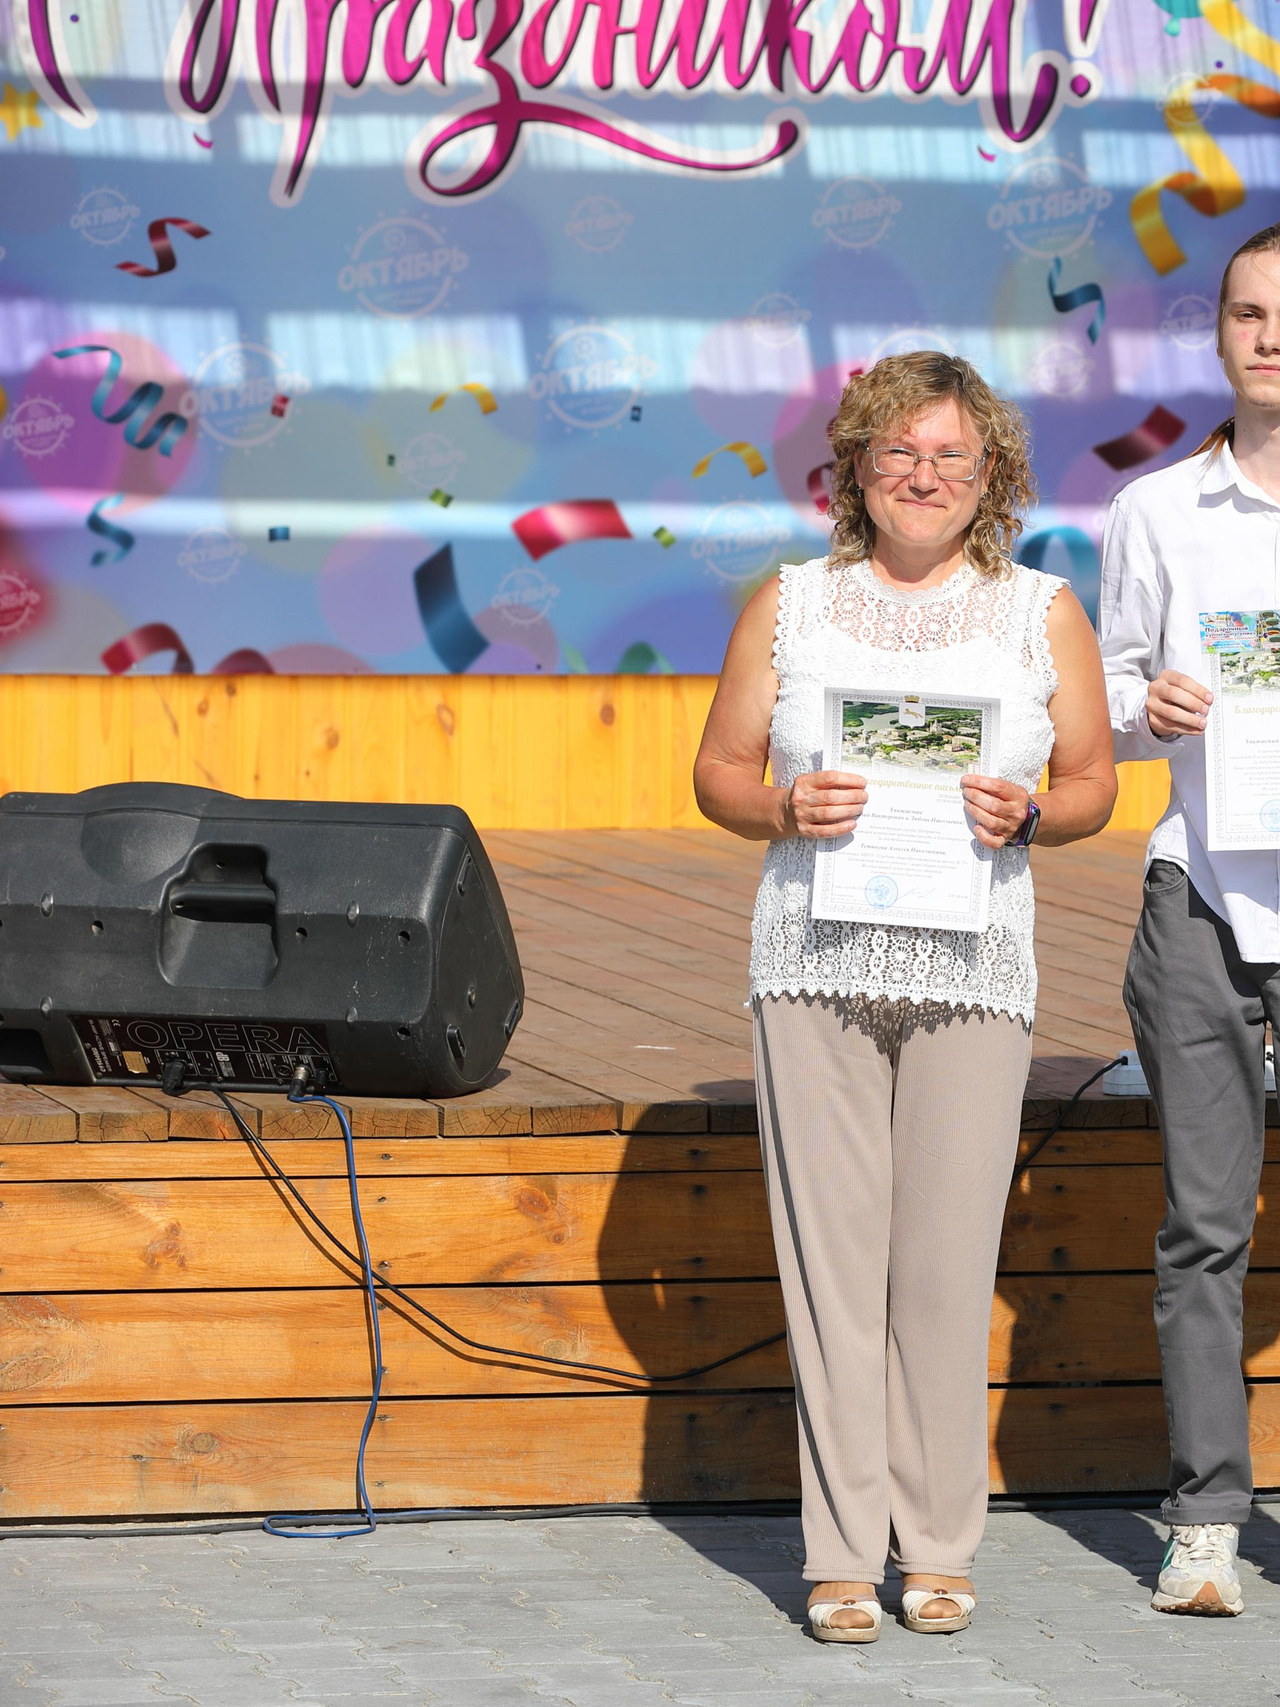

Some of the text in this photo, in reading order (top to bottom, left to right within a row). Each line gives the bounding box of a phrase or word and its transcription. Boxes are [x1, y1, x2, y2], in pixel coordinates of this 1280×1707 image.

[70, 203, 142, 230] ОКТЯБРЬ
[811, 195, 904, 229] ОКТЯБРЬ
[985, 184, 1114, 232] ОКТЯБРЬ
[337, 245, 470, 294] ОКТЯБРЬ
[178, 372, 313, 418] ОКТЯБРЬ
[528, 354, 658, 401] ОКТЯБРЬ
[2, 411, 76, 440] ОКТЯБРЬ
[866, 779, 934, 791] годарственное
[126, 1019, 330, 1055] OPERA
[216, 1051, 230, 1062] dB
